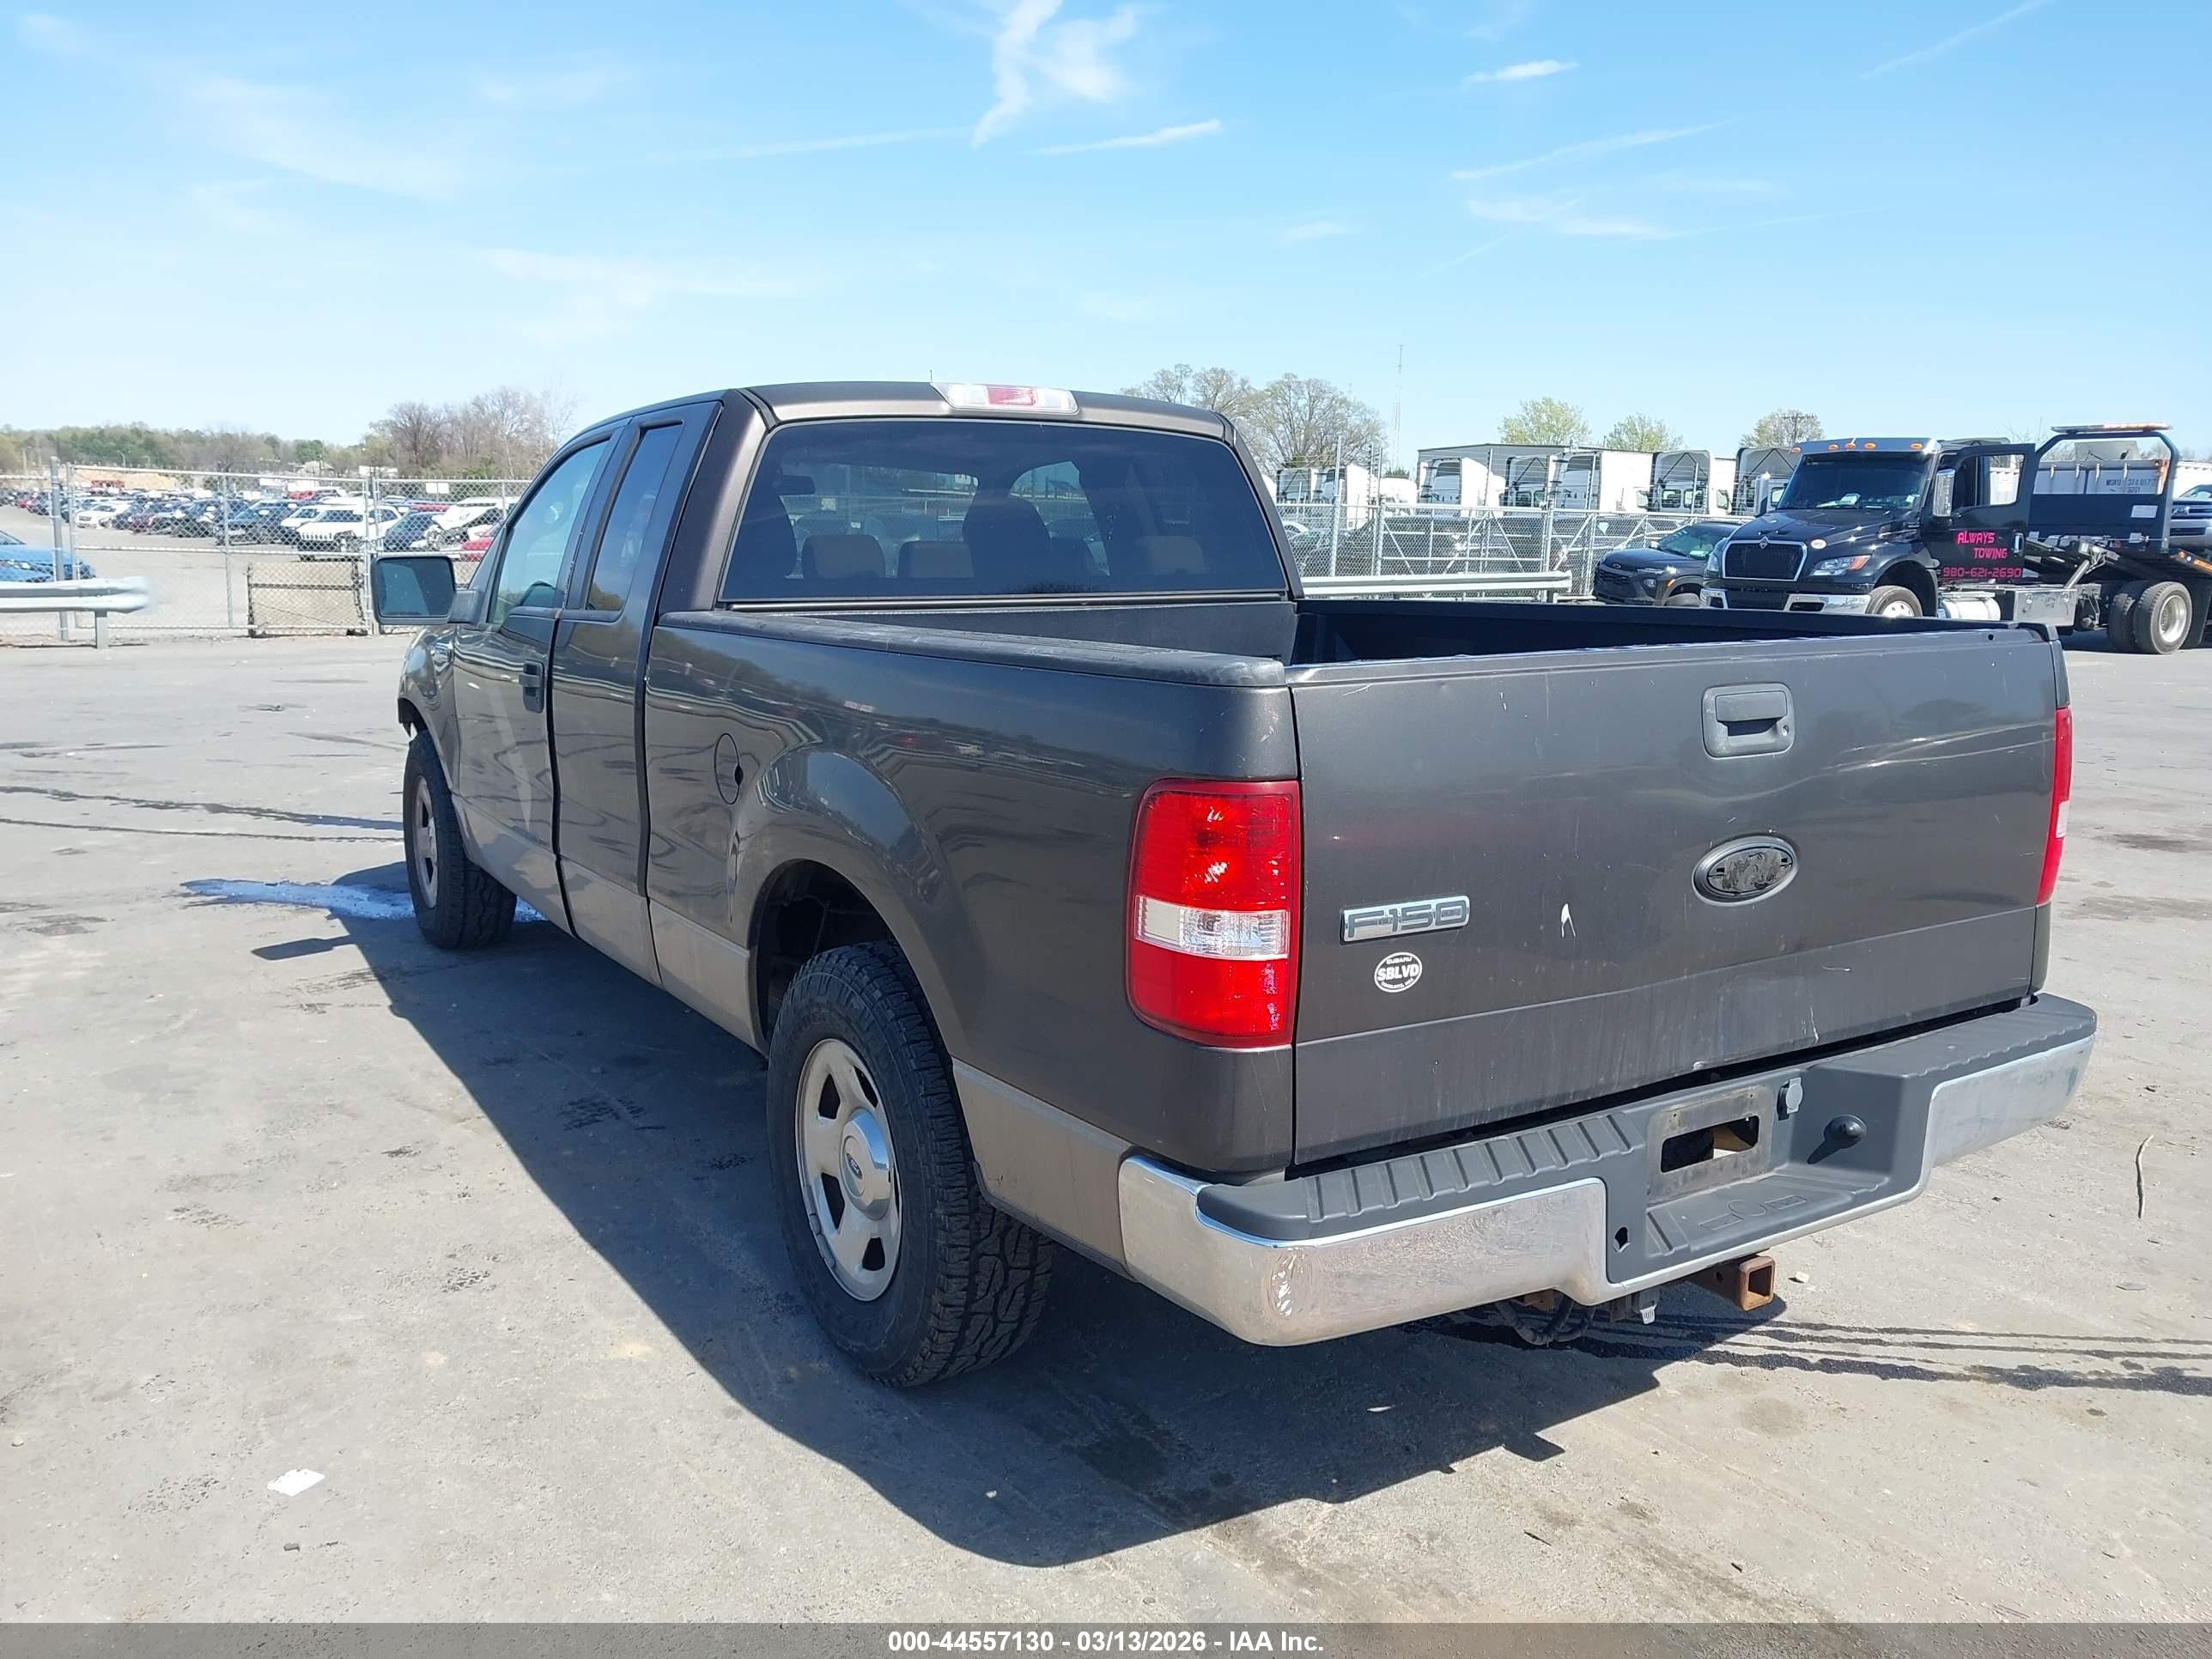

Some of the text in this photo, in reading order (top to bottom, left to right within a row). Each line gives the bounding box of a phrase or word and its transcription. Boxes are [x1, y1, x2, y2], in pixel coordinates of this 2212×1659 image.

[1957, 532, 1995, 544] ALWAYS
[1974, 547, 2008, 559] TOWING
[1943, 567, 2021, 578] 980-621-2690
[1377, 963, 1419, 981] SBLVD
